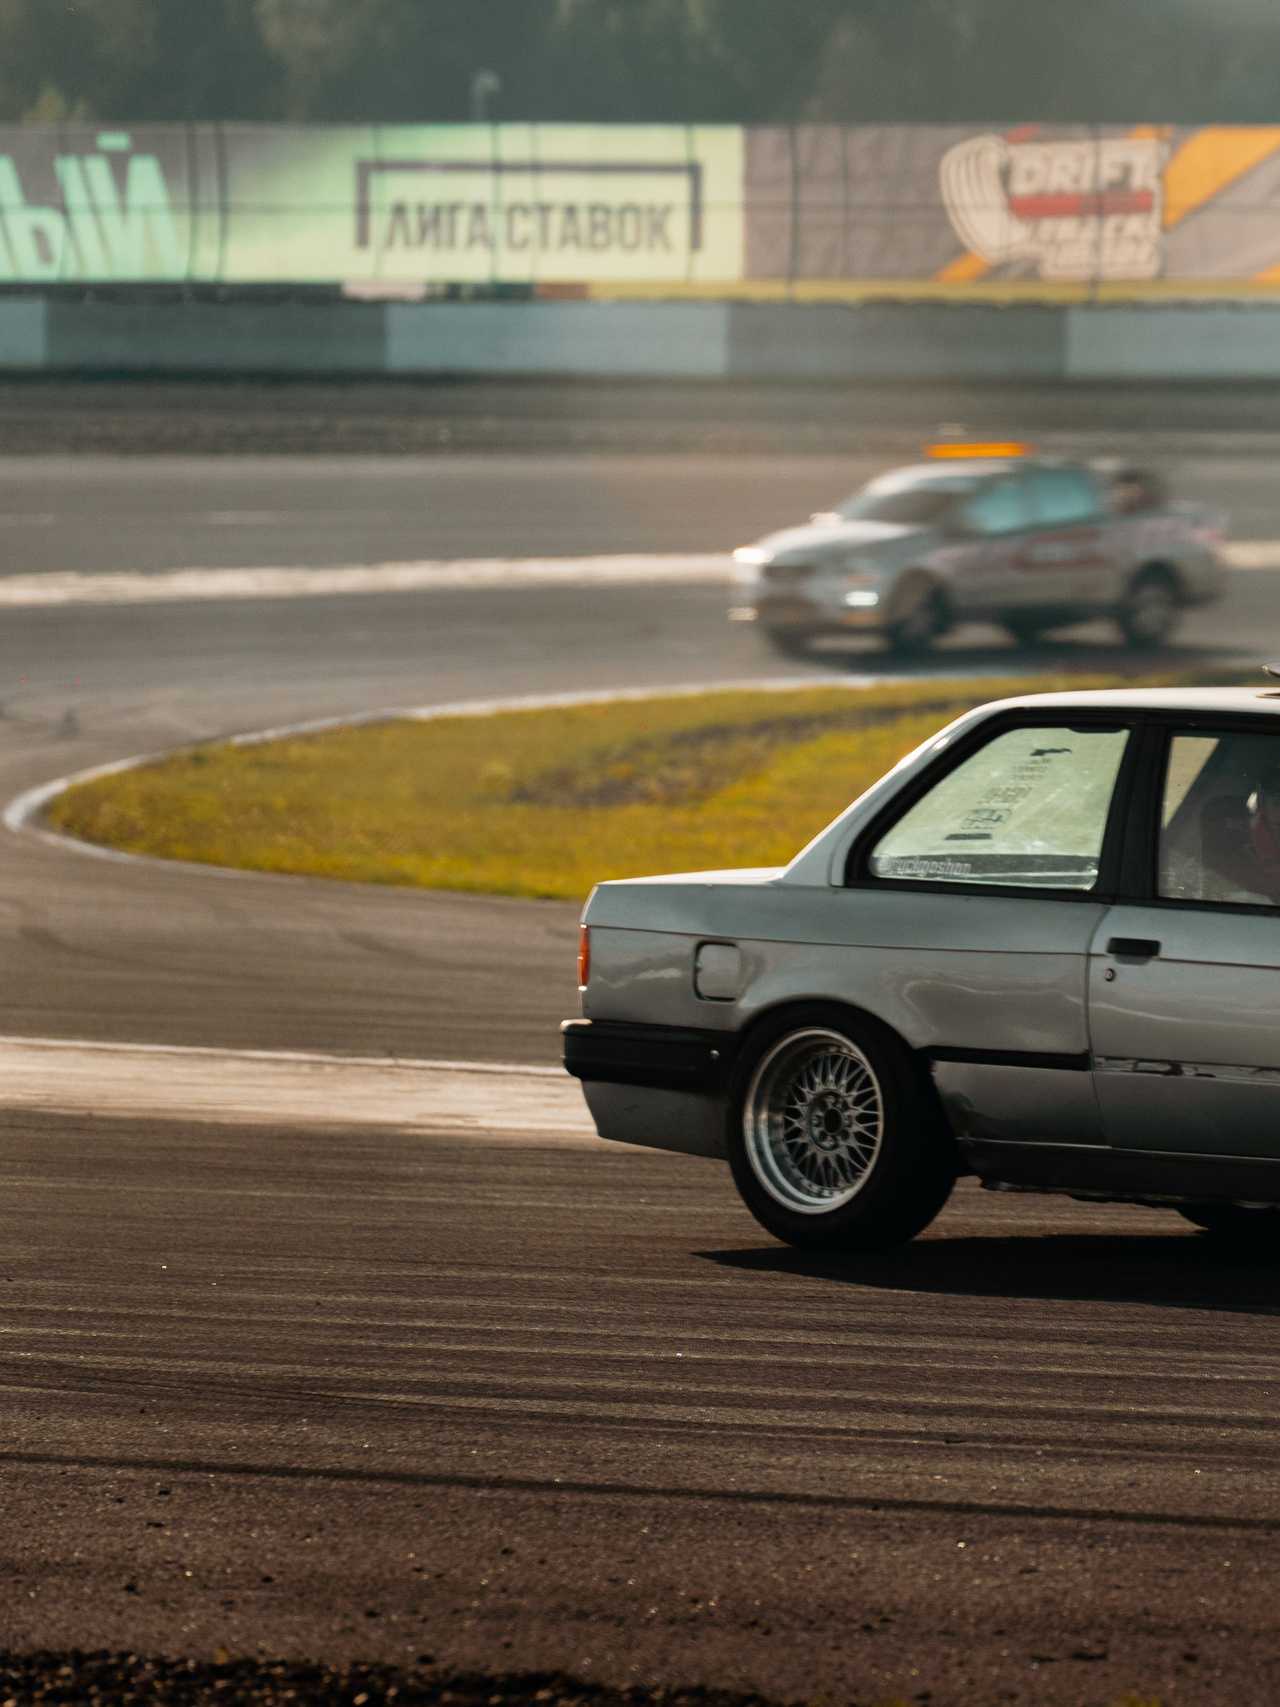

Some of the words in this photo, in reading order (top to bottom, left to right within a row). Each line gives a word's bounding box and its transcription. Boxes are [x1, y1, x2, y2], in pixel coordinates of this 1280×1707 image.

[1009, 150, 1158, 196] DRIFT
[384, 200, 495, 251] ЛИГА
[504, 202, 675, 252] СТАВОК
